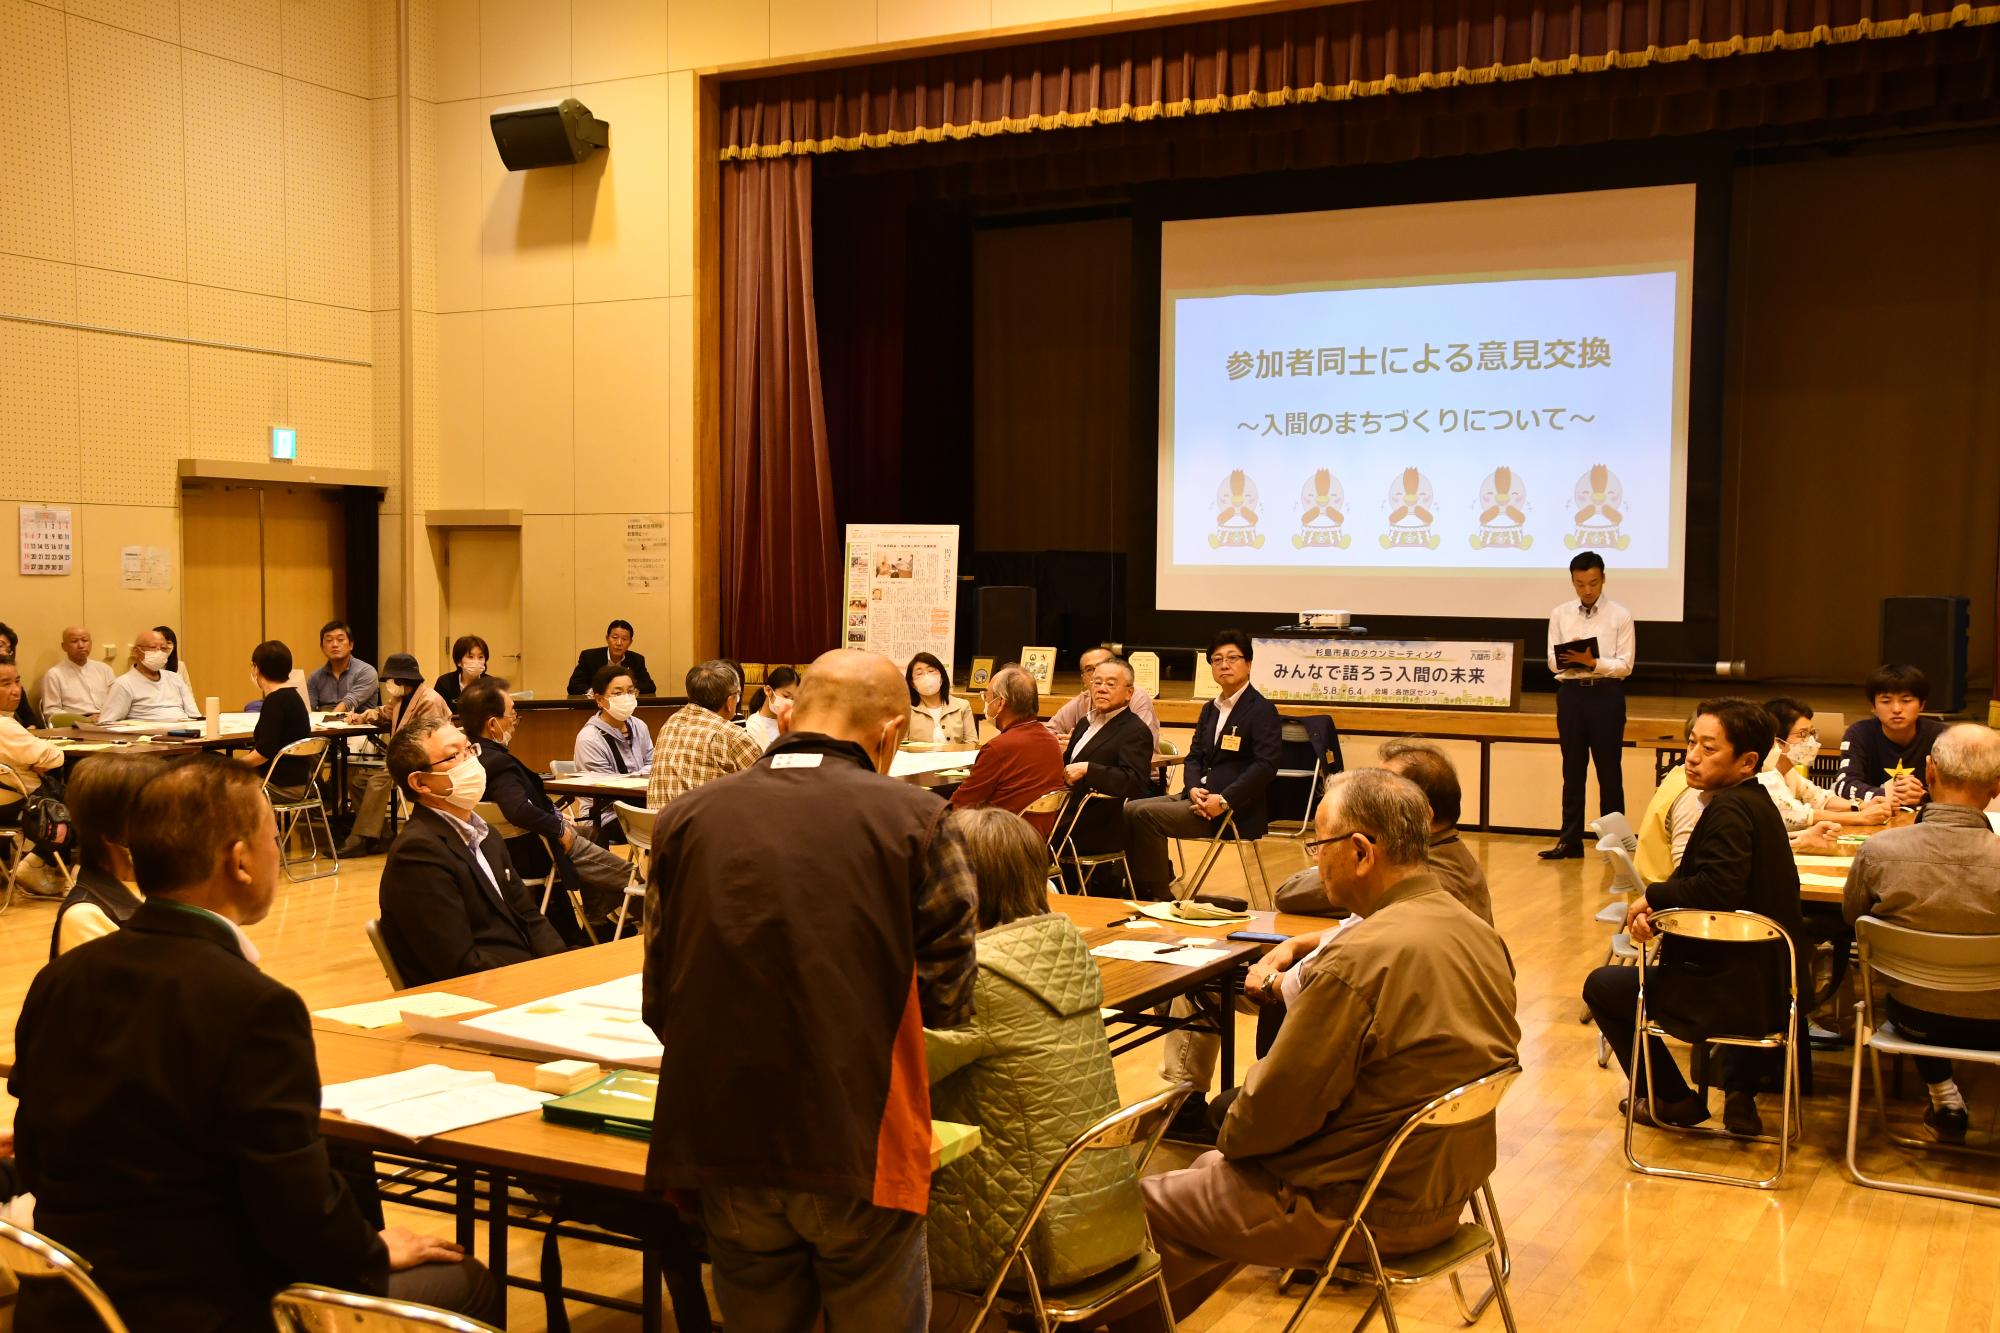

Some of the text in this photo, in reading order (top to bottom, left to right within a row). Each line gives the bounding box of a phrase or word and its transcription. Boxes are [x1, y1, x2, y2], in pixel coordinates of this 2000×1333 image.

[1225, 336, 1612, 381] 参加者同士による意見交換
[1316, 648, 1442, 658] 杉島市長のタウンミーティング
[1274, 664, 1485, 684] みんなで語ろう入間の未来
